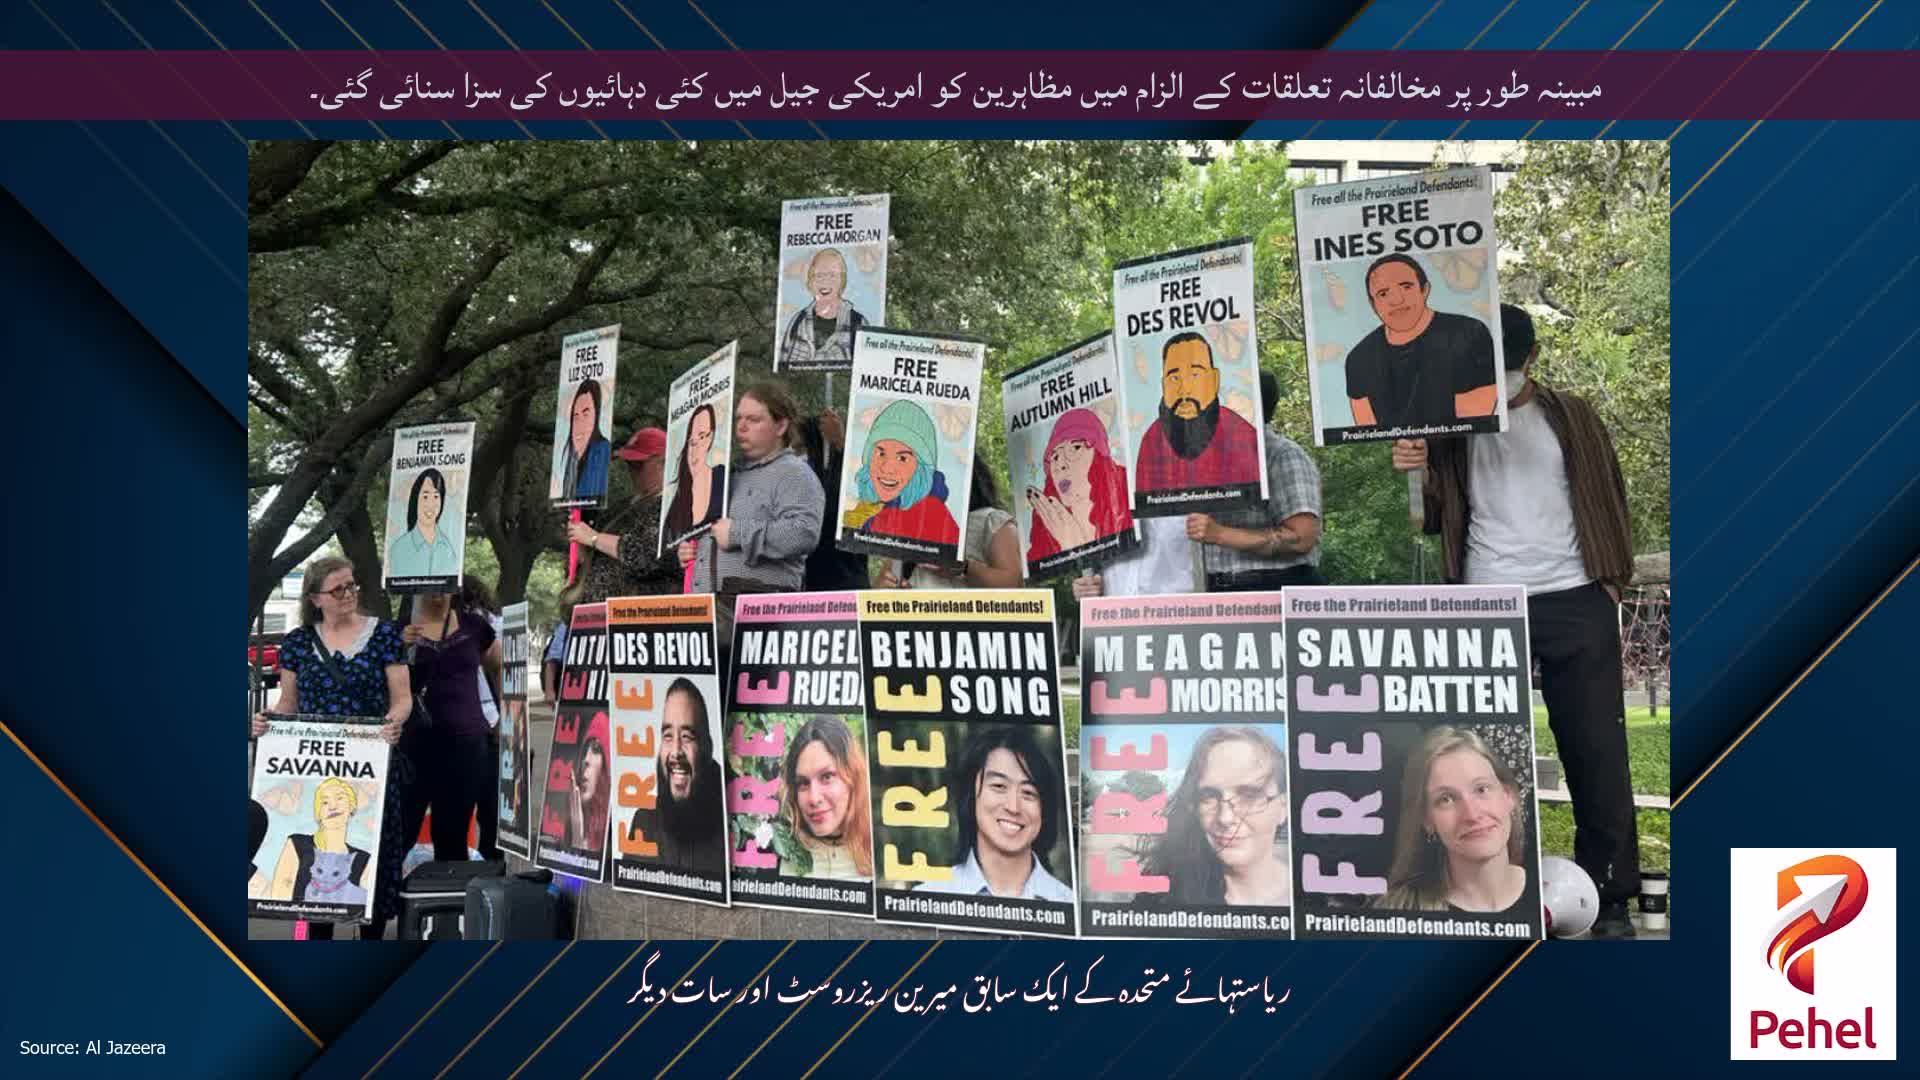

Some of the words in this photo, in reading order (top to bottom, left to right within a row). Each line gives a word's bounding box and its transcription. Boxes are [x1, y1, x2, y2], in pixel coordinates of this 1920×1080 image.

[1311, 193, 1332, 207] Free
[1333, 191, 1346, 204] all
[1348, 188, 1363, 202] the
[1365, 183, 1418, 200] Prairieland
[815, 213, 854, 230] FREE
[1361, 199, 1430, 228] FREE
[786, 232, 832, 246] REBECCA
[833, 229, 881, 243] MORGAN
[1314, 232, 1385, 262] INES
[1394, 220, 1484, 252] SOTO
[1160, 276, 1201, 304] FREE
[1127, 309, 1163, 337] DES
[1169, 296, 1240, 330] REVOL
[575, 345, 598, 364] FREE
[893, 357, 938, 379] FREE
[568, 367, 580, 383] LIZ
[581, 362, 604, 380] SOTO
[688, 370, 710, 398] FREE
[1041, 370, 1075, 399] FREE
[860, 374, 922, 395] MARICELA
[926, 382, 970, 401] RUEDA
[1011, 391, 1076, 433] AUTUMN
[1079, 377, 1112, 404] HILL
[1342, 422, 1473, 441] PrairielandDefendants.com
[416, 438, 445, 455] FREE
[396, 455, 436, 470] BENJAMIN
[438, 453, 466, 466] SONG
[743, 604, 760, 615] Free
[762, 603, 776, 615] the
[779, 602, 825, 615] Prairieland
[866, 600, 890, 613] Free
[892, 600, 910, 613] the
[912, 600, 973, 614] Prairieland
[975, 600, 1044, 614] Defendants!
[1090, 608, 1118, 621] Free
[1119, 608, 1140, 620] the
[1143, 604, 1213, 619] Prairieland
[1291, 598, 1321, 612] Free
[1324, 598, 1346, 612] the
[1349, 598, 1427, 612] Prairieland
[1430, 597, 1517, 612] Defendants!
[567, 635, 609, 665] AUTU
[613, 632, 648, 666] DES
[653, 631, 712, 666] REVOL
[740, 629, 858, 665] MARICEL
[870, 630, 1047, 671] BENJAMIN
[1297, 627, 1519, 668] SAVANNA
[587, 670, 609, 700] HI
[793, 670, 865, 706] RUED
[950, 674, 1050, 717] SONG
[1383, 674, 1519, 713] BATTEN
[298, 739, 346, 757] FREE
[542, 670, 588, 838] FREE
[266, 757, 375, 779] SAVANNA
[614, 676, 659, 857] FREE
[727, 671, 791, 869] FREE
[873, 674, 953, 882] FREE
[1089, 676, 1170, 893] FREE
[1296, 673, 1388, 895] FREE
[884, 895, 1065, 925] PrairielandDefendants.com
[1092, 909, 1289, 930] PrairielandDefendants.co
[1305, 914, 1531, 938] PrairielandDefendants.com
